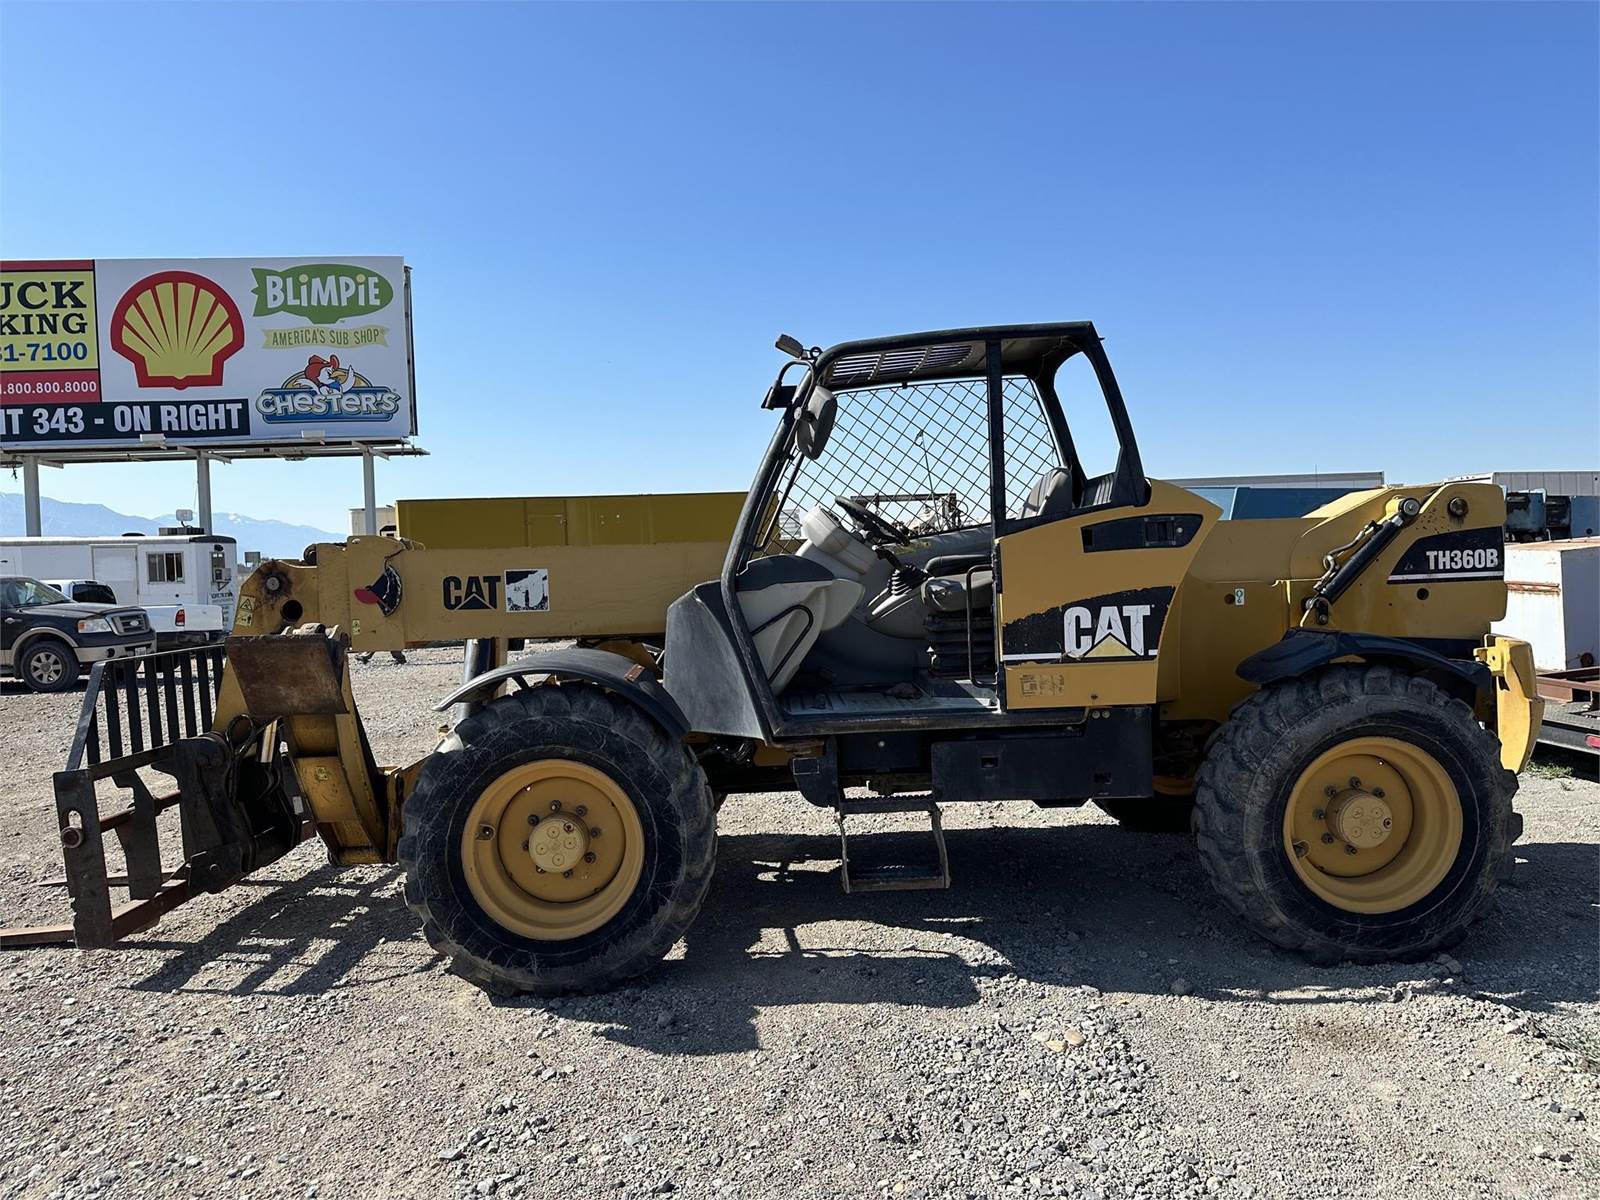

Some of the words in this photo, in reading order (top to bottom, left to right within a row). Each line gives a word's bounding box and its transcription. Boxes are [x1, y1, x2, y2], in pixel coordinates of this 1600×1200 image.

[0, 341, 88, 362] 1-7100
[329, 330, 349, 346] SUB
[32, 406, 85, 435] 343
[113, 405, 152, 433] ON
[160, 402, 243, 432] RIGHT
[1426, 548, 1499, 570] TH360B
[442, 575, 501, 611] CAT
[1063, 604, 1151, 659] CAT
